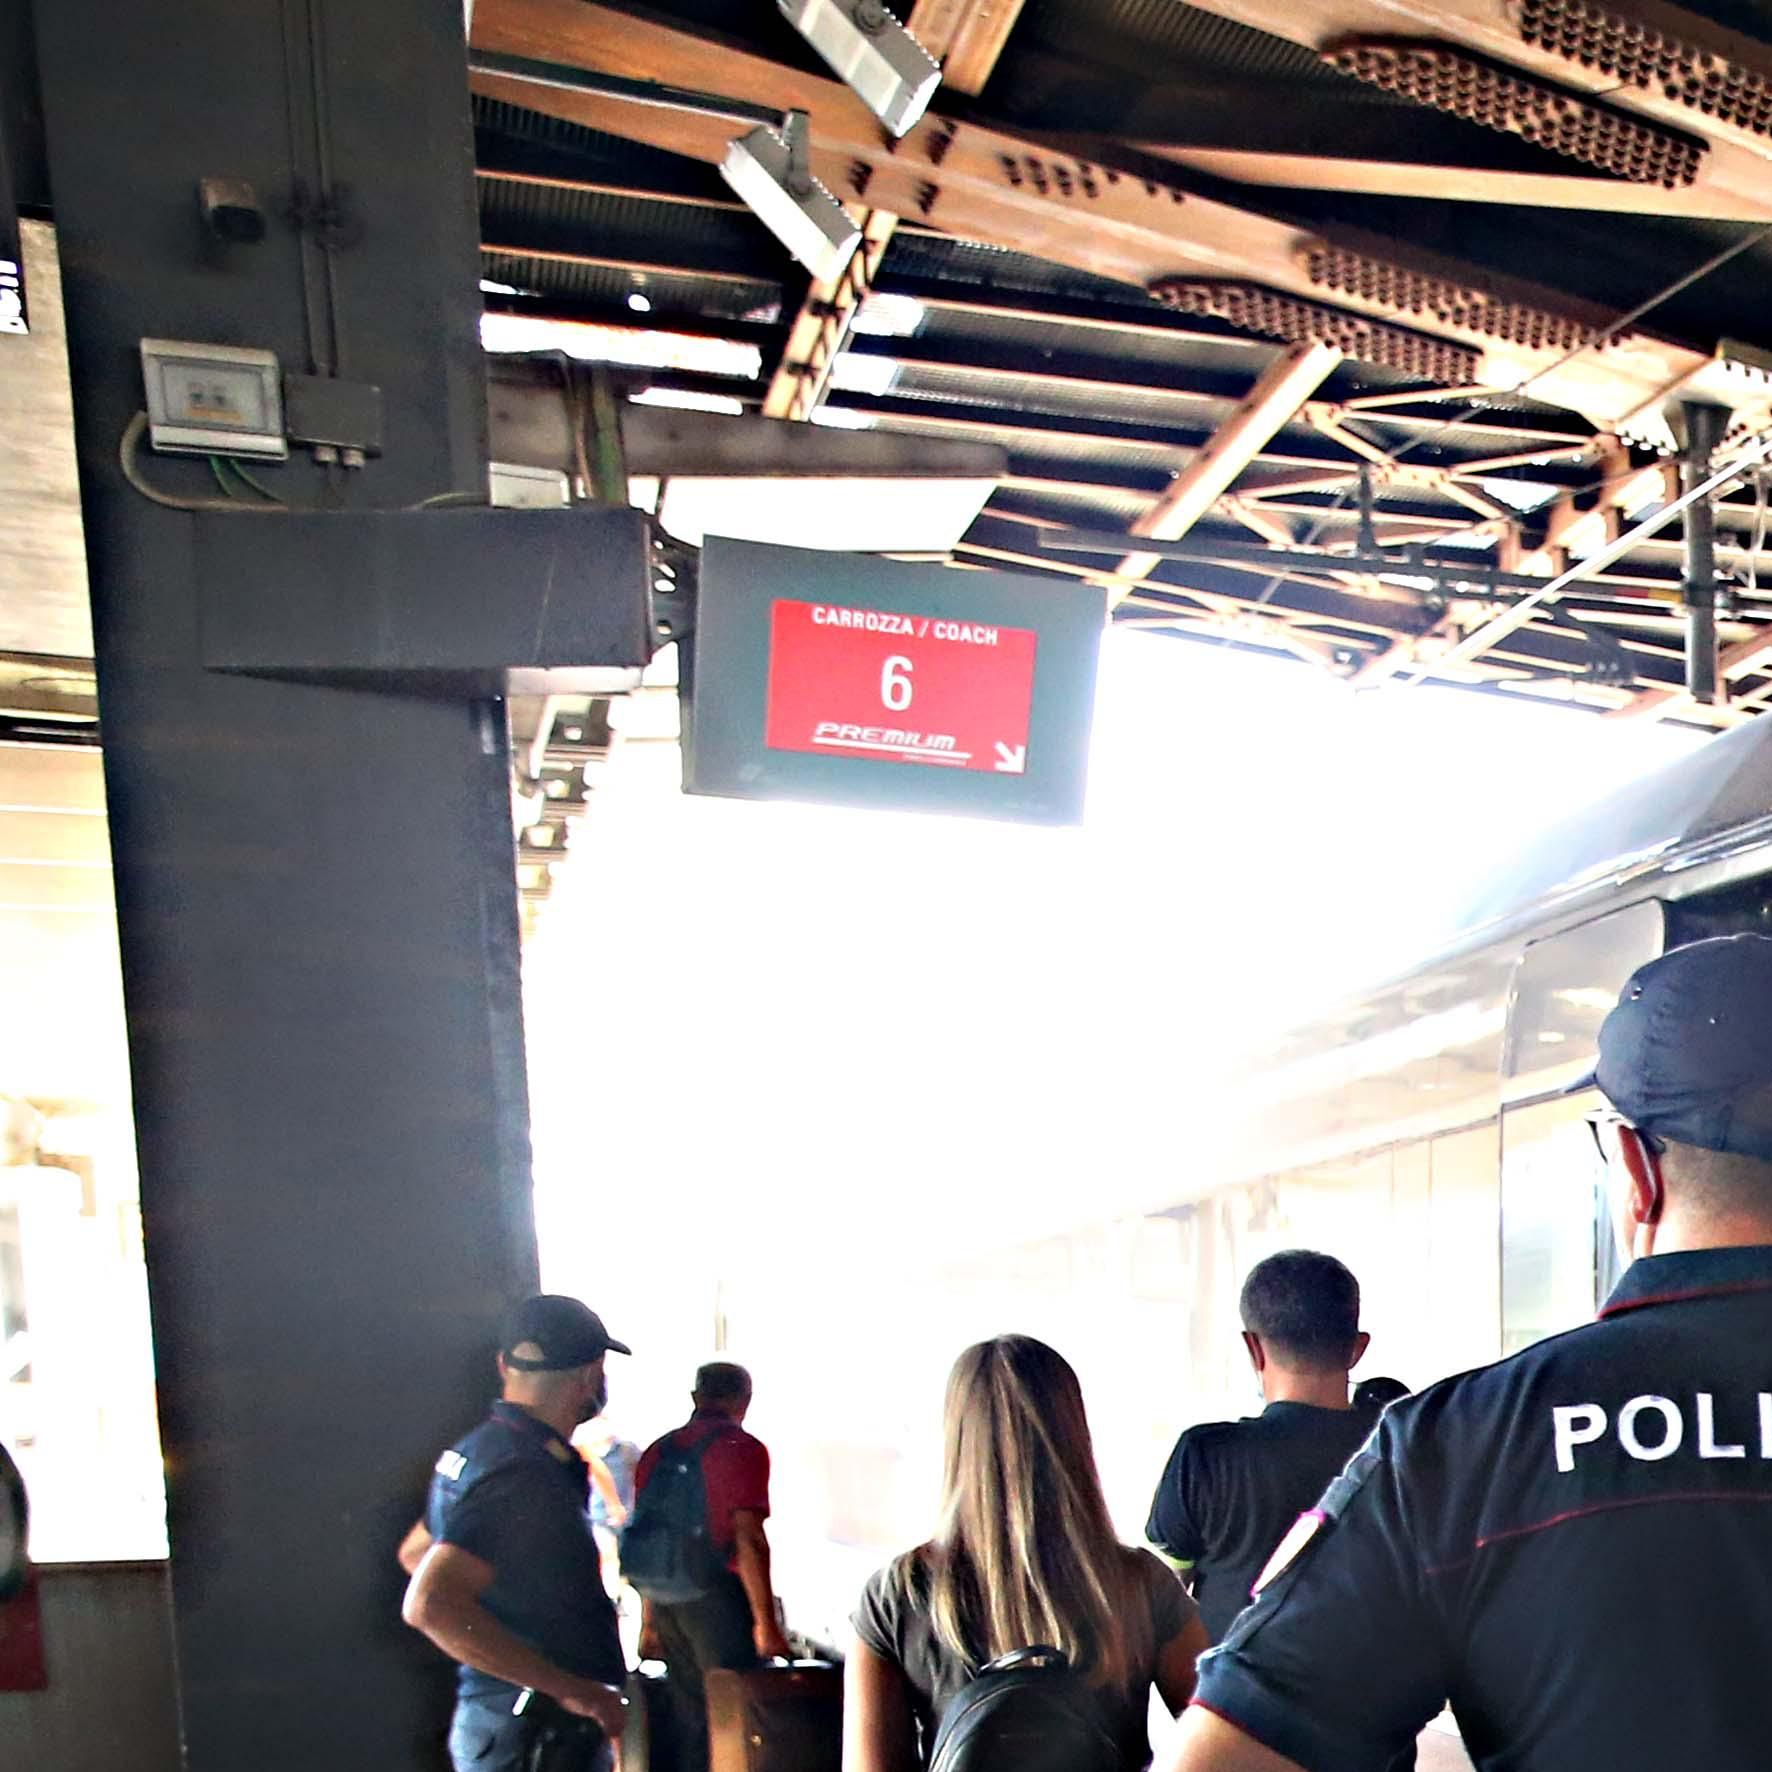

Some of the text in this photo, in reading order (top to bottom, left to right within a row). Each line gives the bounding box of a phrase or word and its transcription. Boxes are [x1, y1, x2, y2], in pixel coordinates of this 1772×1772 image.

[812, 606, 914, 635] CARROZZA
[933, 622, 998, 645] COACH
[881, 655, 913, 711] 6
[815, 722, 956, 750] PREMIUM
